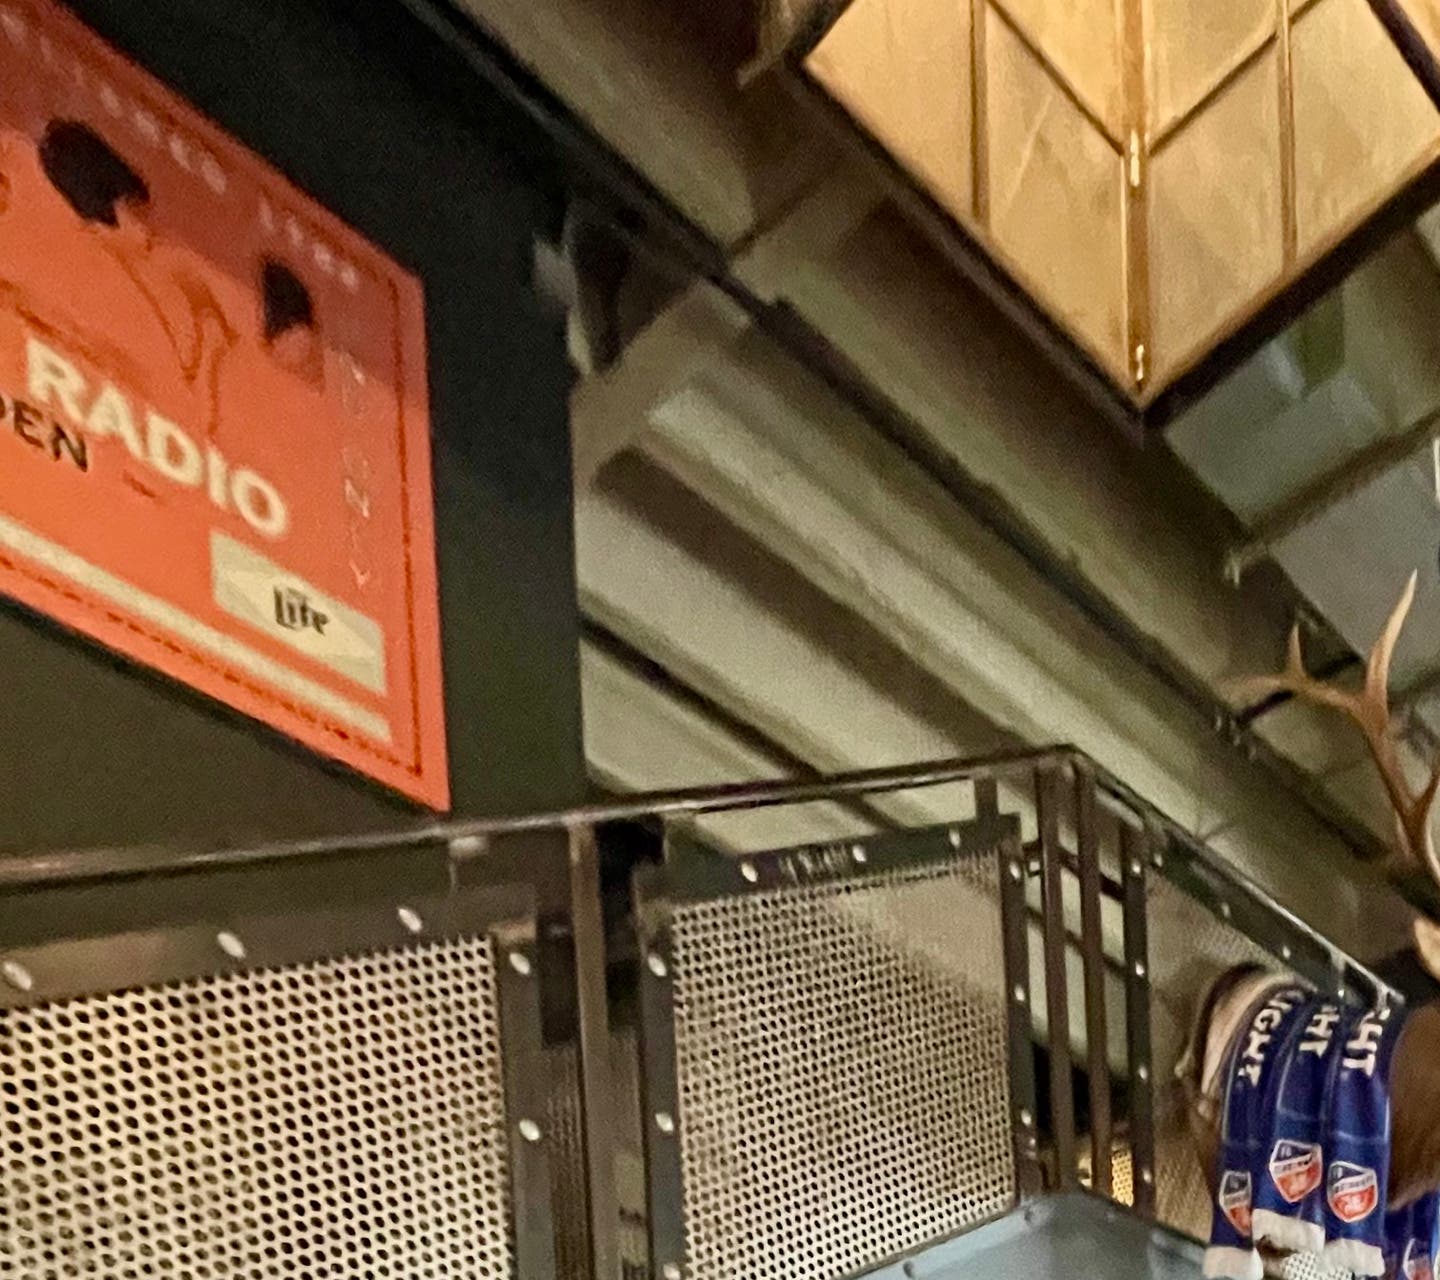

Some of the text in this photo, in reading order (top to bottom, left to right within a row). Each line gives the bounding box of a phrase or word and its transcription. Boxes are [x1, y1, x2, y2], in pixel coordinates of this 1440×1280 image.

[0, 395, 89, 473] EN
[25, 334, 290, 538] RADIO
[273, 587, 330, 637] Lite
